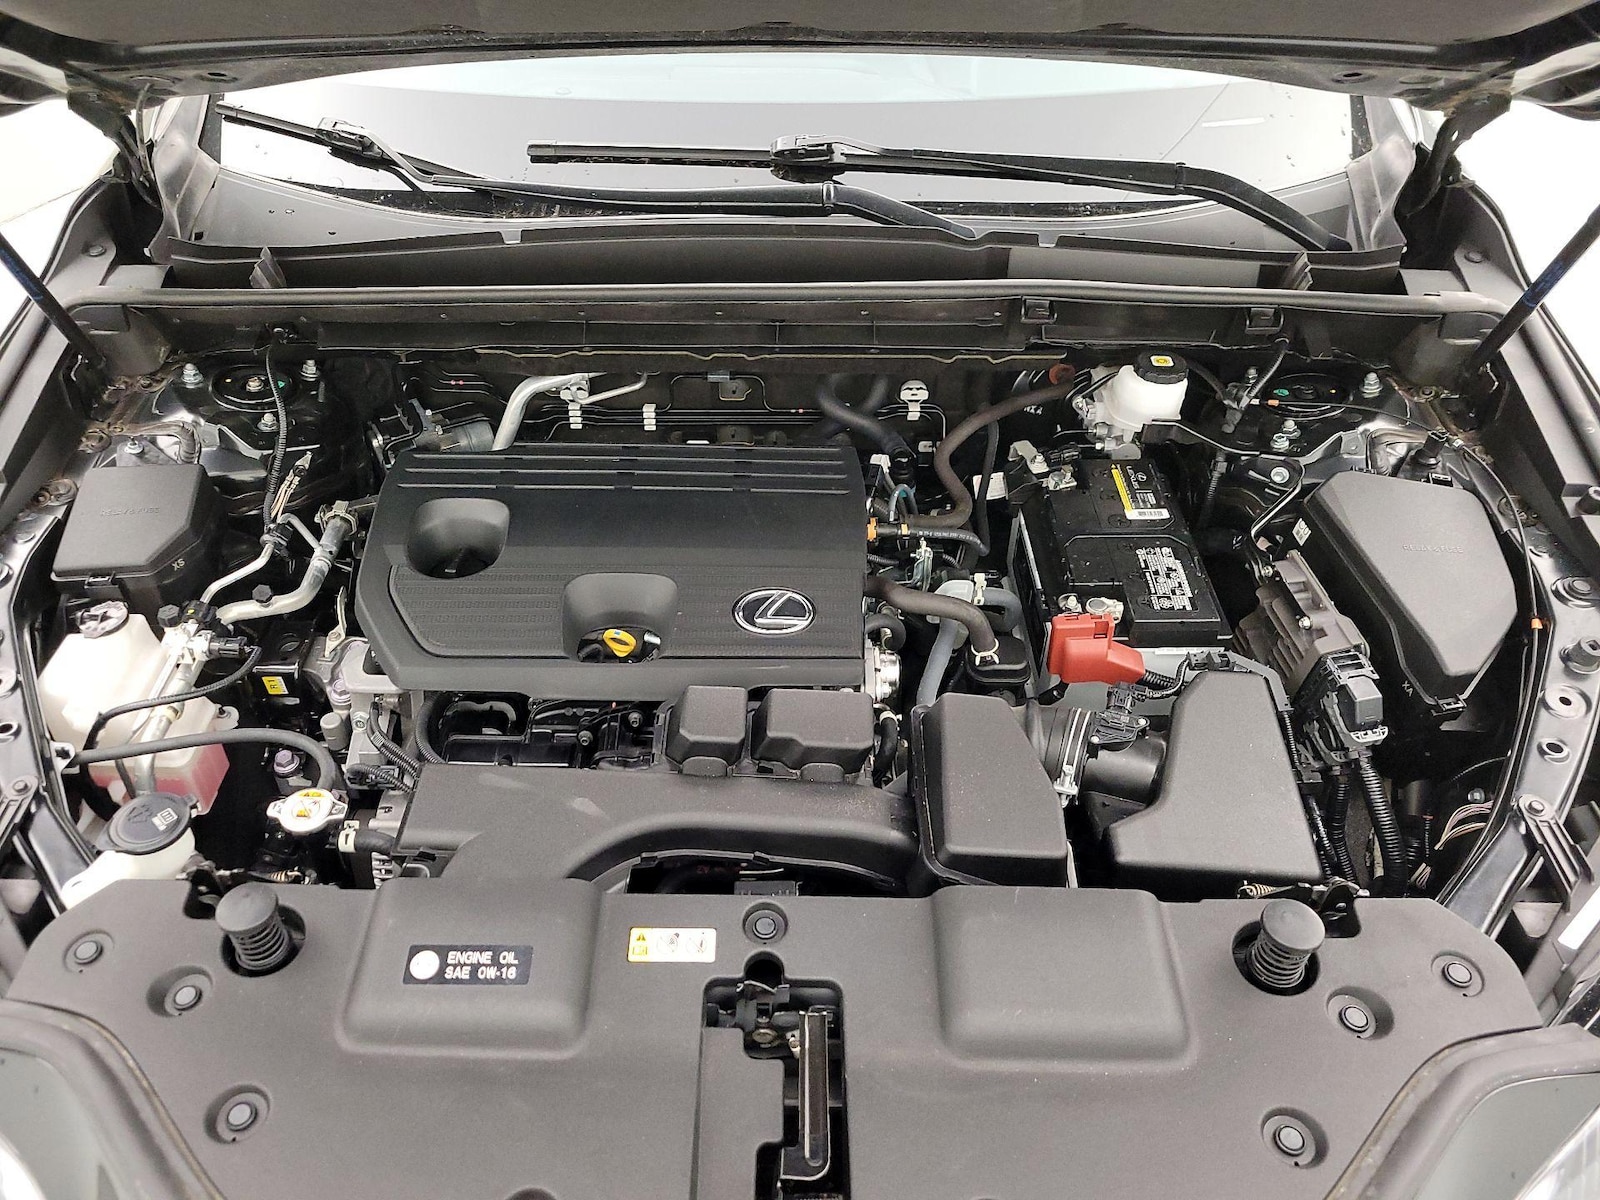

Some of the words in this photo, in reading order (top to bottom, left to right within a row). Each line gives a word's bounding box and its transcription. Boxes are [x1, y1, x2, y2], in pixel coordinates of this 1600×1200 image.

[1126, 465, 1140, 489] LEXUS
[446, 951, 493, 964] ENGINE
[499, 951, 519, 964] OIL
[444, 966, 470, 979] SAE
[477, 966, 517, 979] 0W-16
